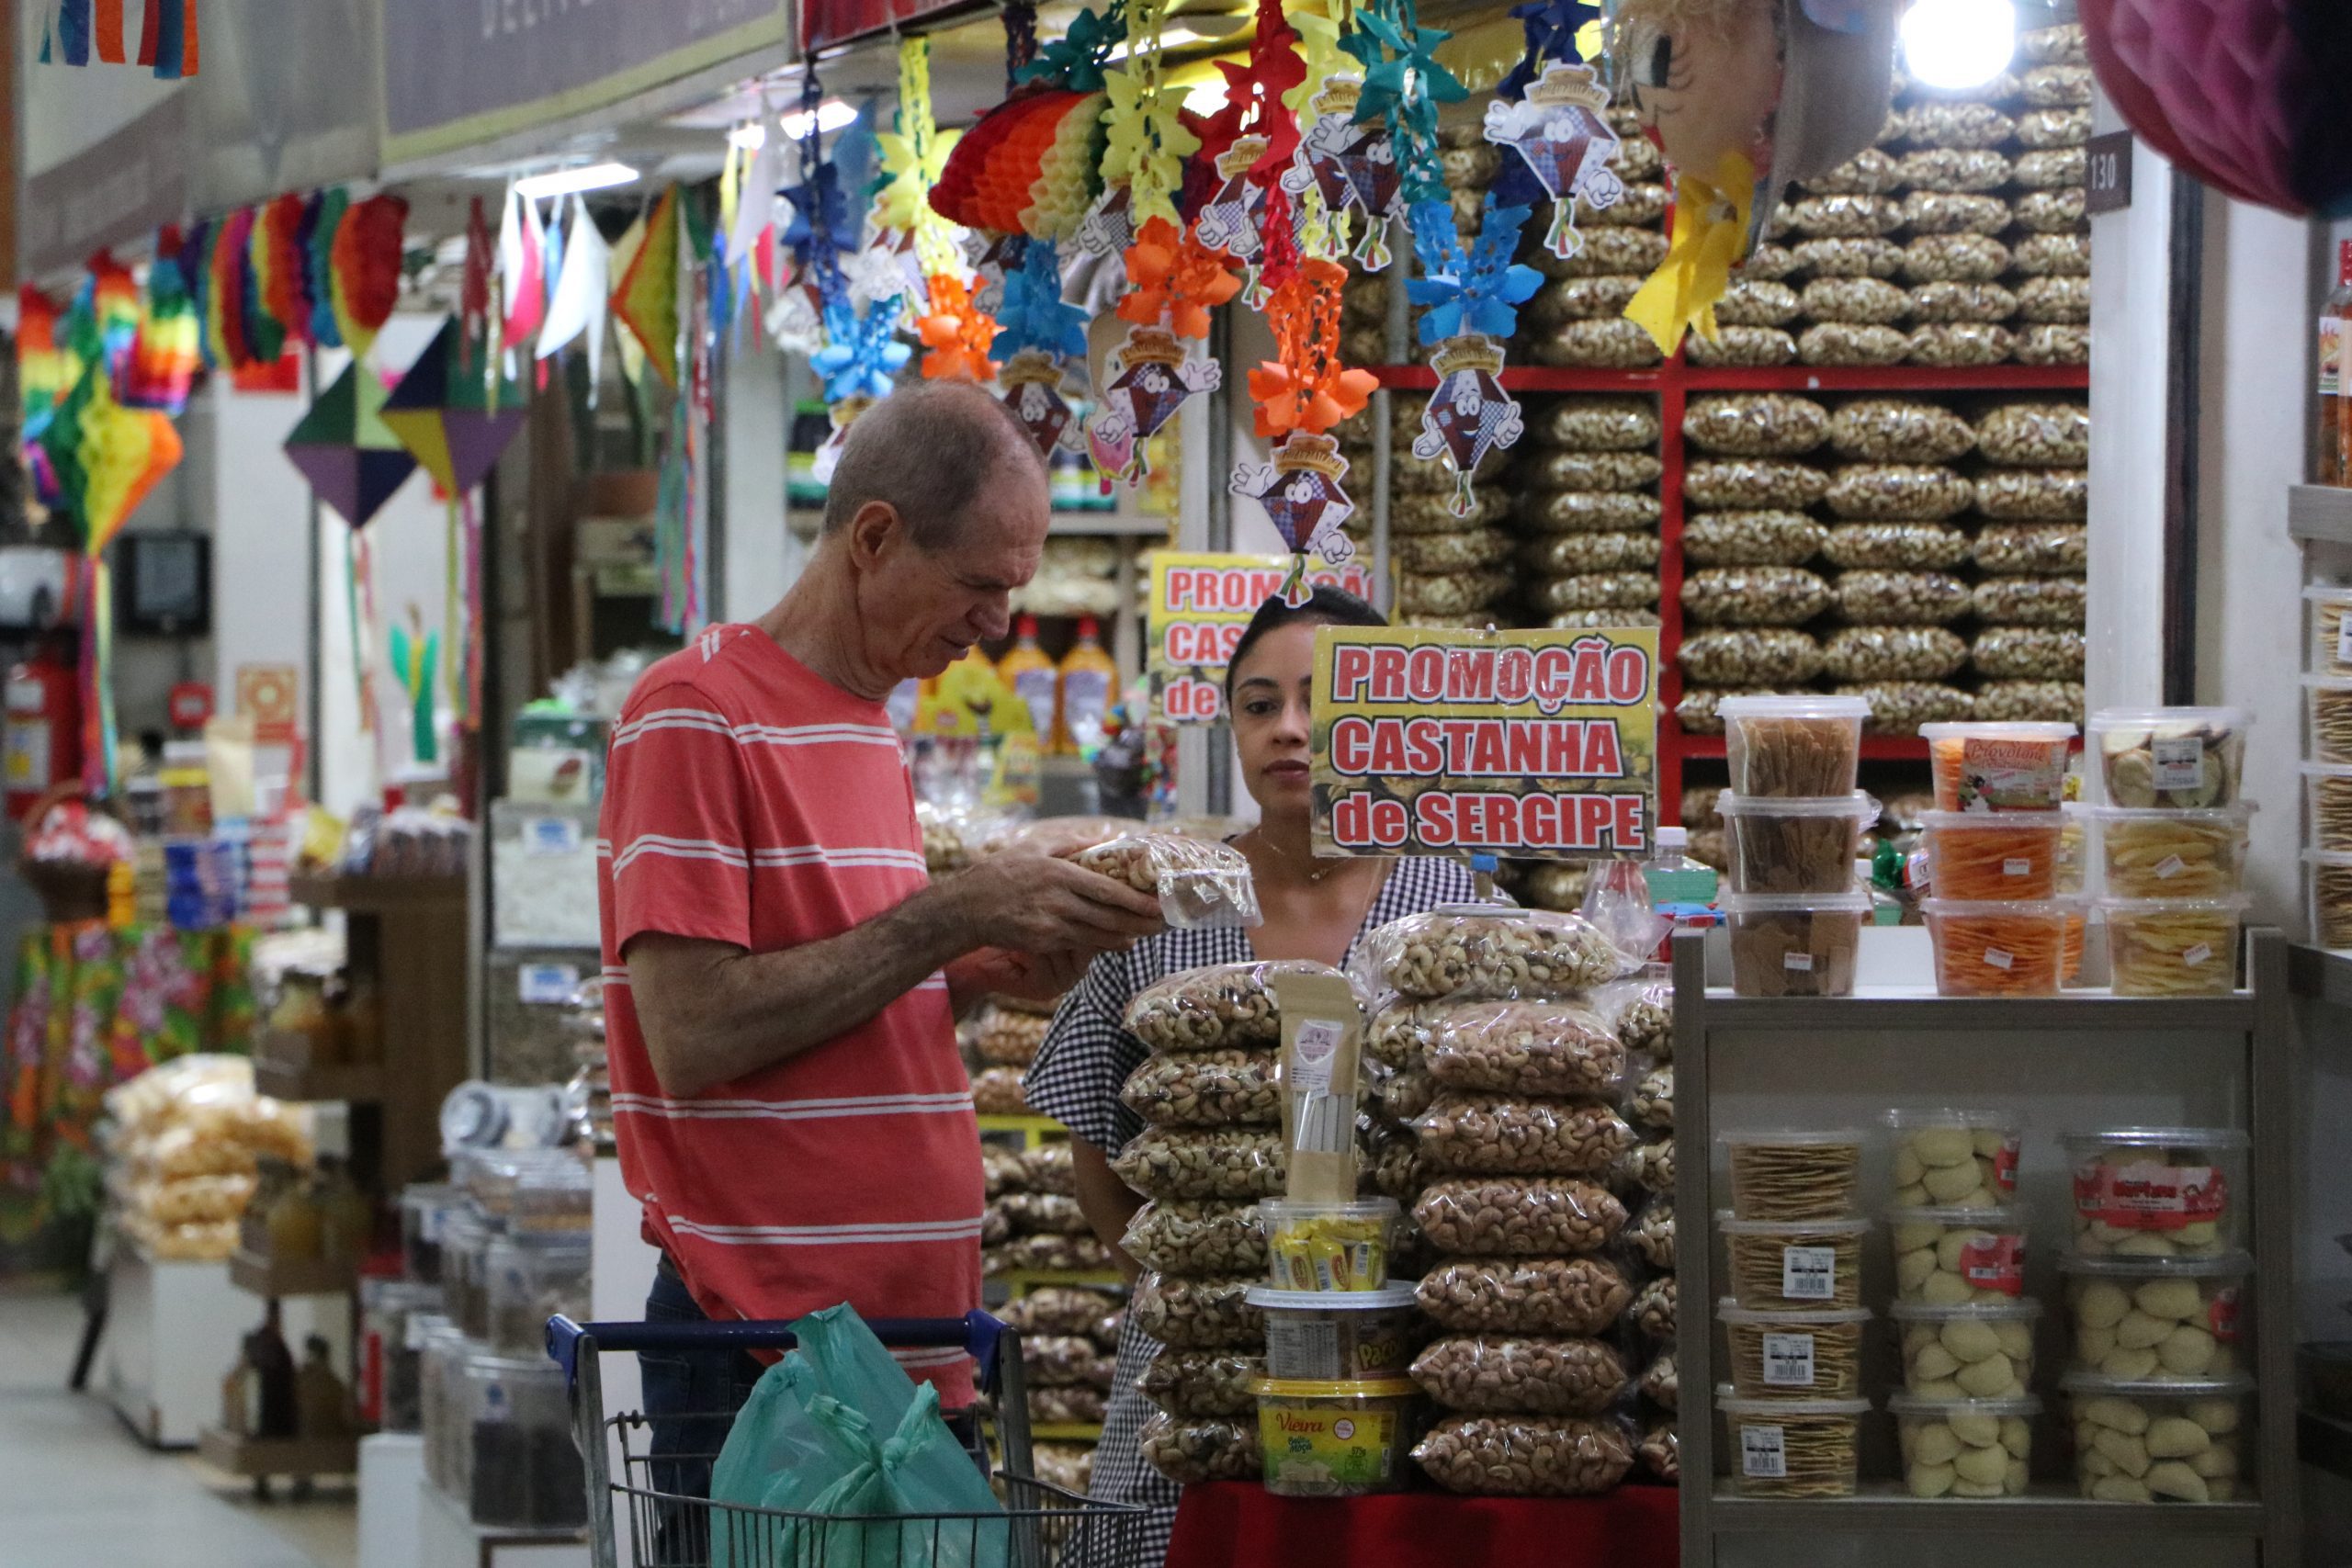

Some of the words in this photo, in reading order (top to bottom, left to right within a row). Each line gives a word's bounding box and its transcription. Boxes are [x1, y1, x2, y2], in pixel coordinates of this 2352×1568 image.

[2090, 152, 2116, 191] 130
[1164, 676, 1219, 720] de
[1332, 636, 1648, 715] PROMOÇÃO
[1331, 717, 1624, 777] CASTANHA
[1333, 791, 1408, 846] de
[1416, 792, 1645, 851] SERGIPE
[1276, 1412, 1326, 1433] Vieira
